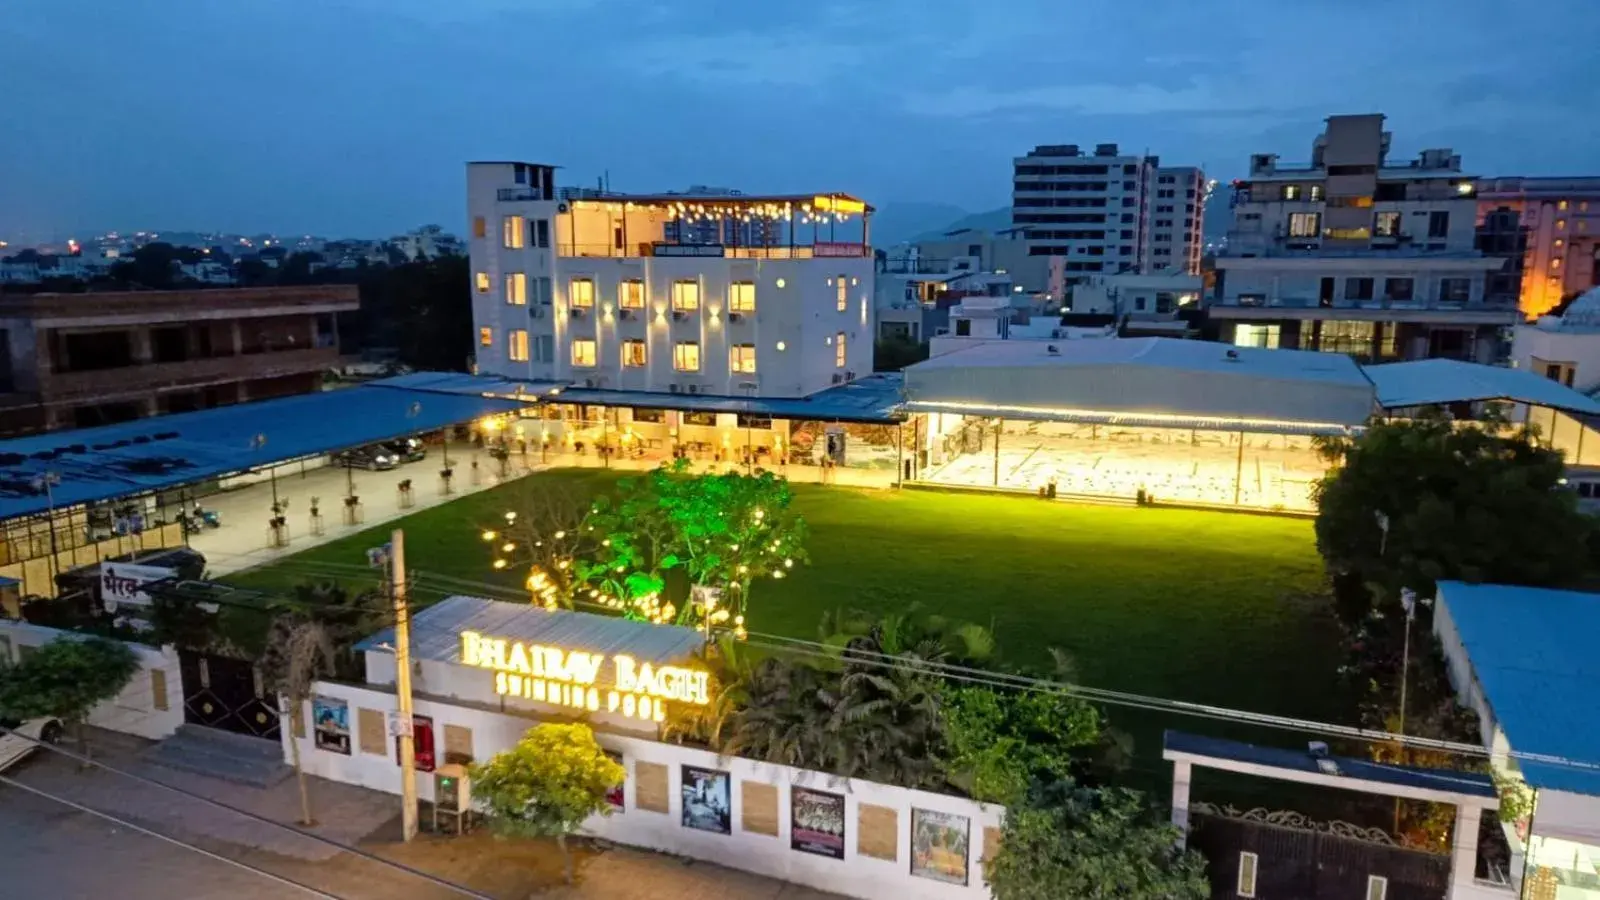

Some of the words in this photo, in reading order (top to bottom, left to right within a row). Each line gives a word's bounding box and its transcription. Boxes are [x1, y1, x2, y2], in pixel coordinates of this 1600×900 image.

[103, 567, 138, 597] भैरव
[461, 630, 604, 684] BHAIRAV
[613, 655, 709, 705] BAGH
[495, 671, 599, 712] SWIMMING
[607, 690, 666, 722] POOL
